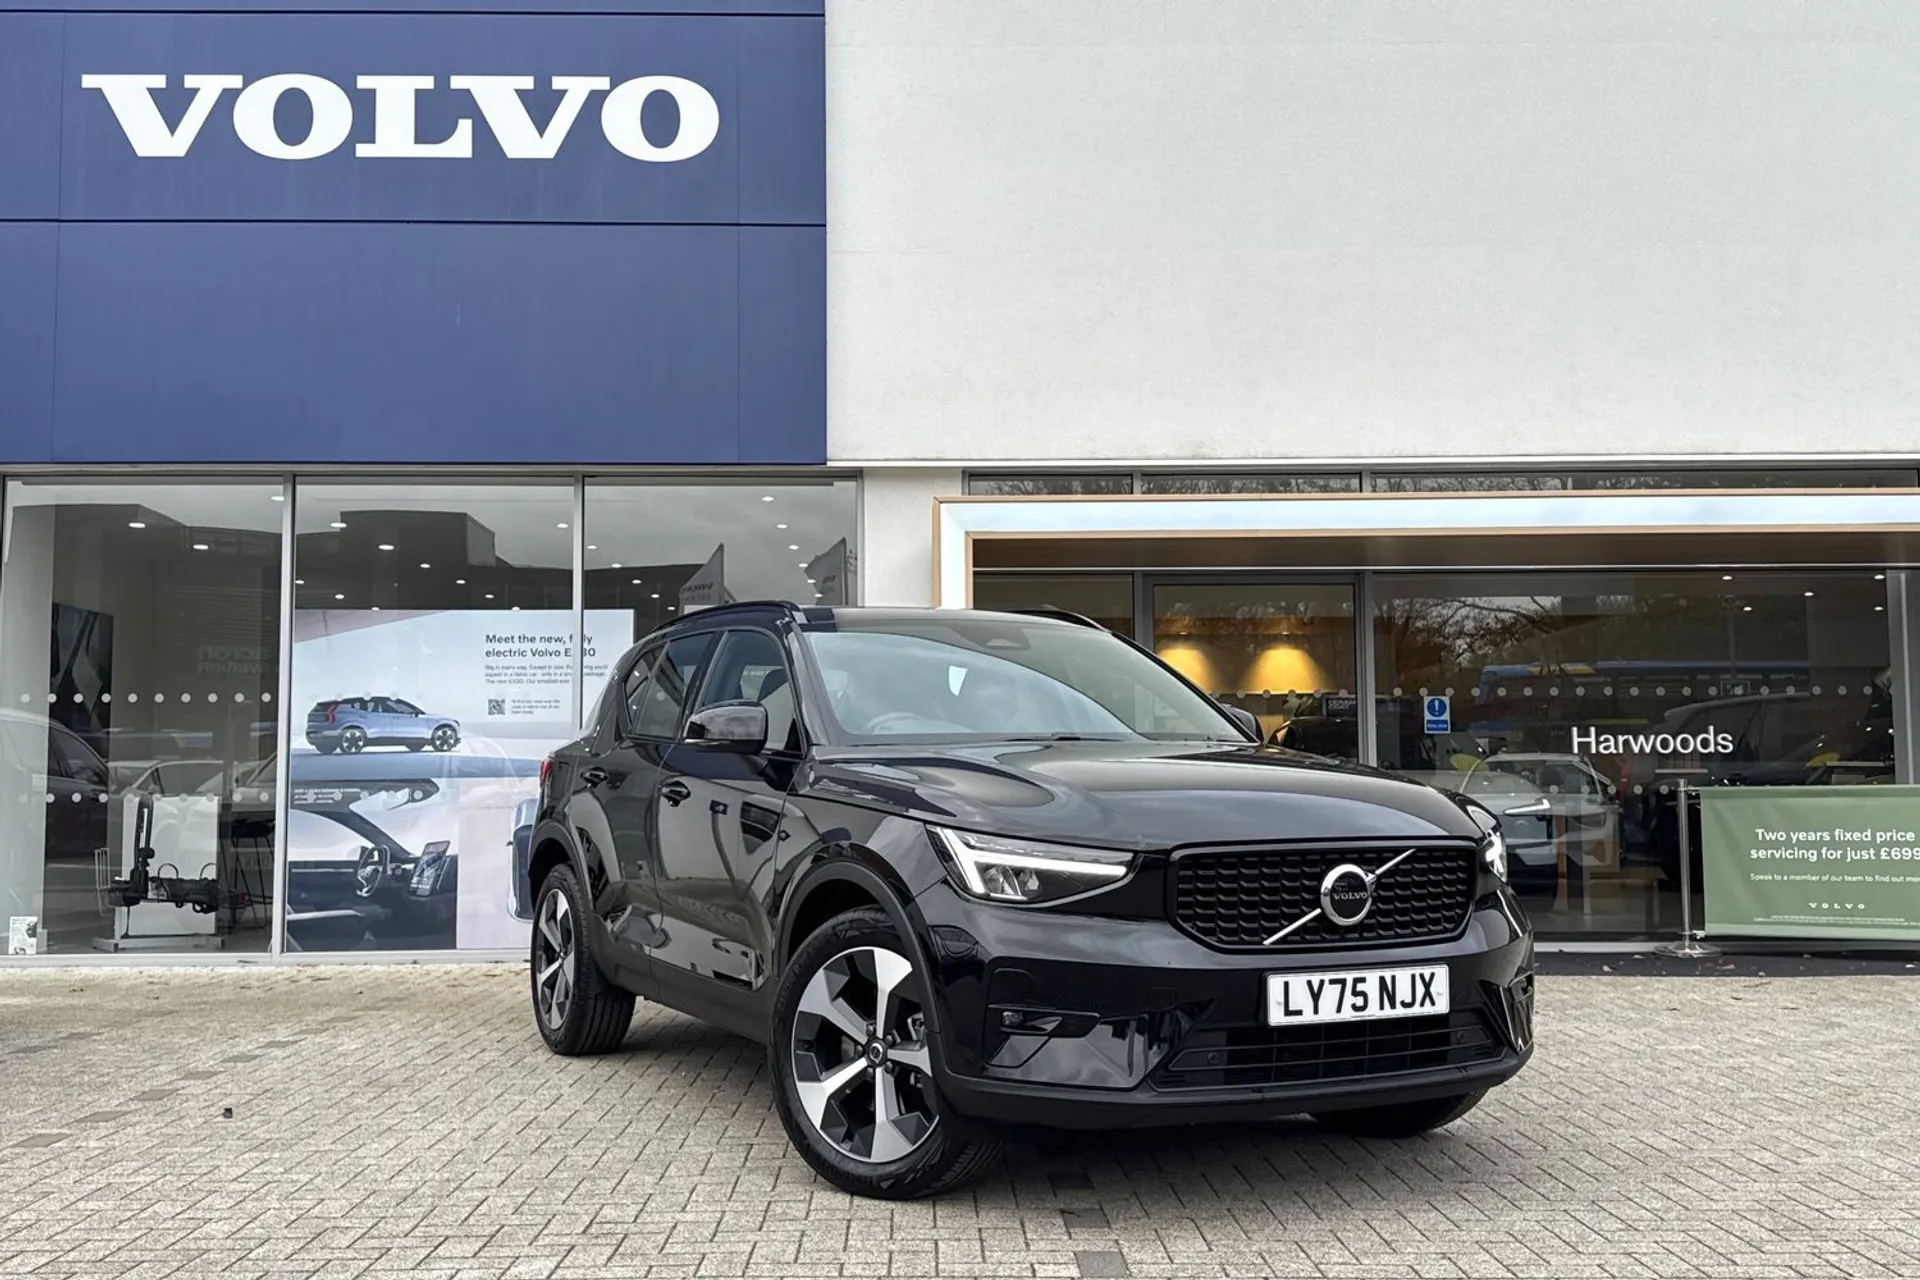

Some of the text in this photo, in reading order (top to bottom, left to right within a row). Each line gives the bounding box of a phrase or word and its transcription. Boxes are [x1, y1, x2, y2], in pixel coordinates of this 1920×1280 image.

[81, 74, 719, 162] VOLVO
[485, 634, 593, 646] Meet the new, fly
[485, 648, 596, 658] electric Volvo E30
[1571, 725, 1734, 755] Harwoods
[1755, 829, 1915, 843] Two years fixed price
[1750, 847, 1920, 862] servicing for just £699
[1750, 873, 1772, 881] Speak
[1789, 873, 1819, 881] member
[1821, 873, 1829, 881] of
[1844, 873, 1863, 881] team
[1865, 874, 1873, 882] to
[1875, 874, 1889, 882] find
[1333, 891, 1367, 900] VOLVO
[1283, 972, 1436, 1017] LY75 NJX
